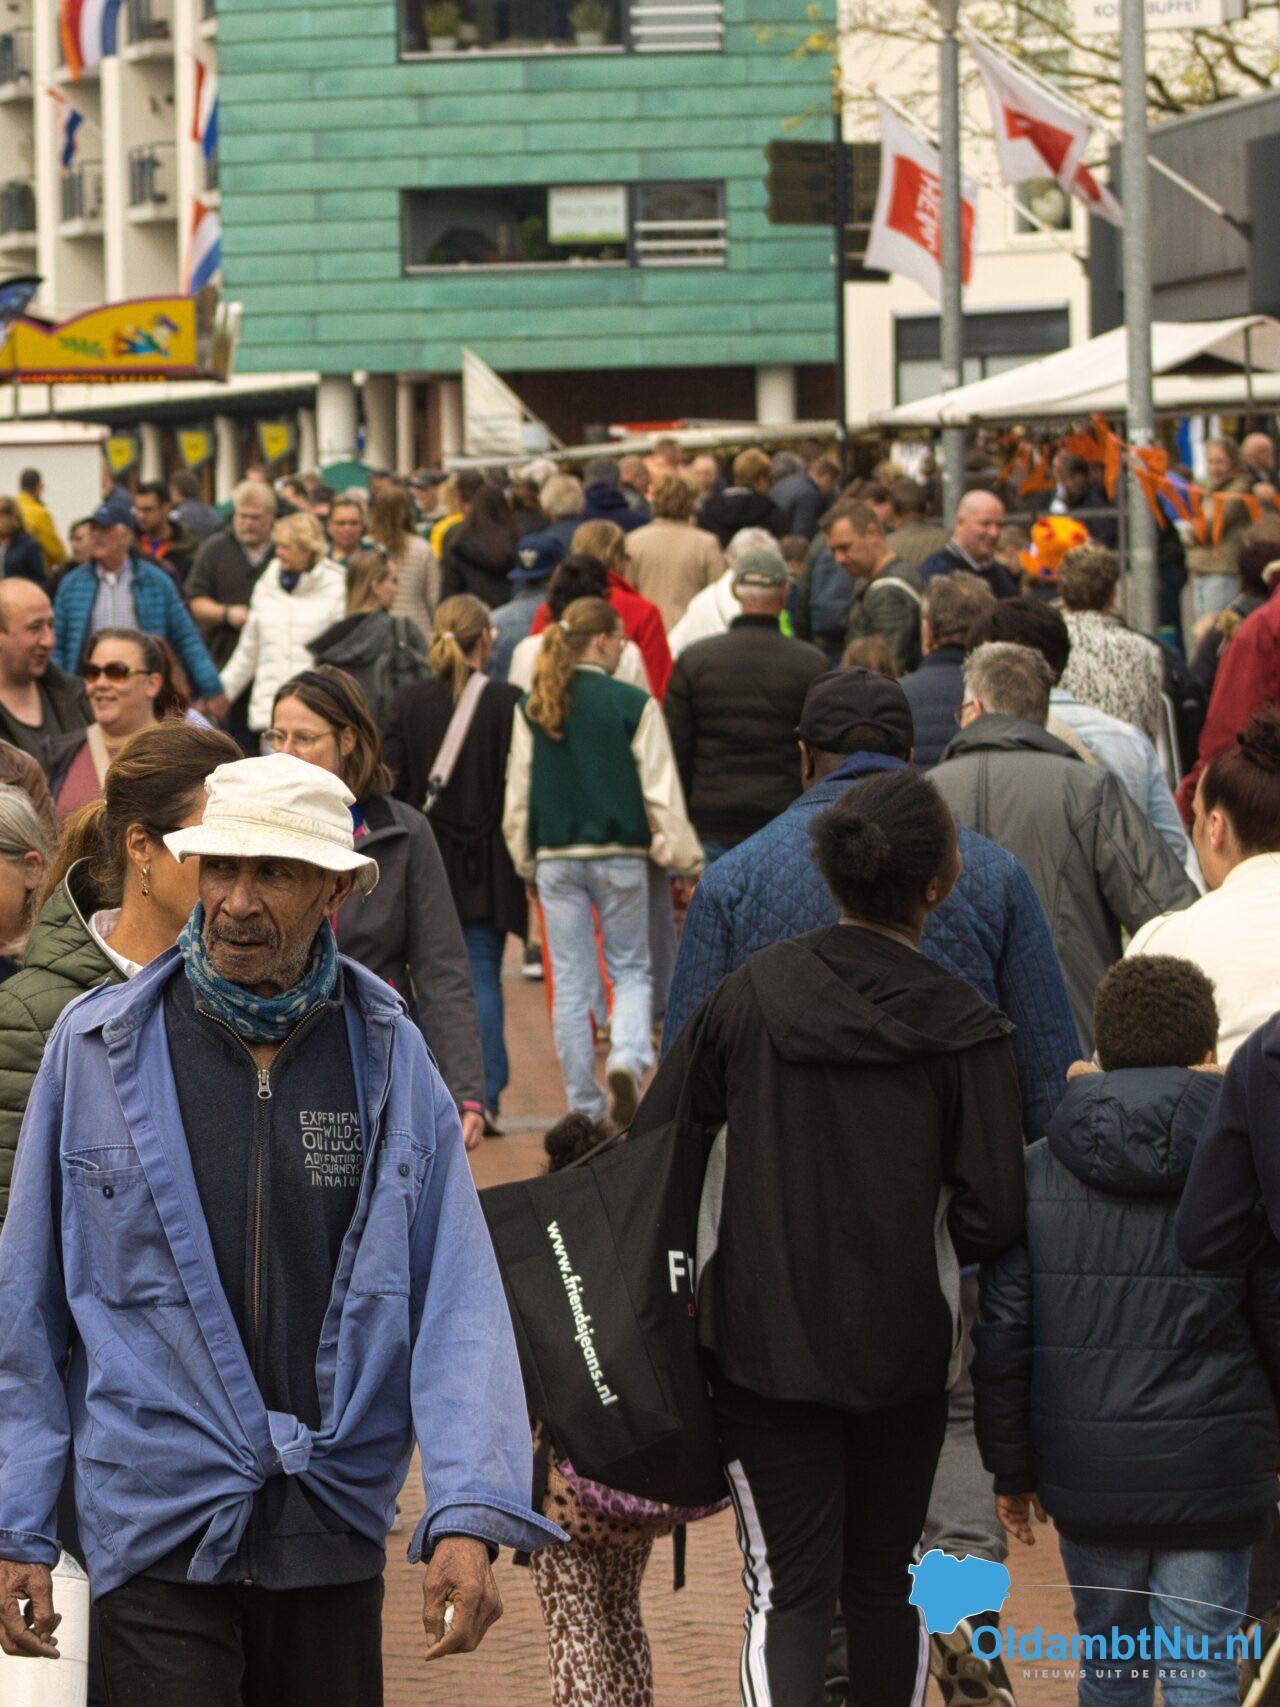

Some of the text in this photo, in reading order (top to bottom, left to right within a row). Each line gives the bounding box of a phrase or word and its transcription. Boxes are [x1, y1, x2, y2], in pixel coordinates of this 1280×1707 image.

[302, 1131, 363, 1151] OUTDOO
[323, 1125, 352, 1139] WILD
[546, 1219, 619, 1406] www.friendsjeans.nl
